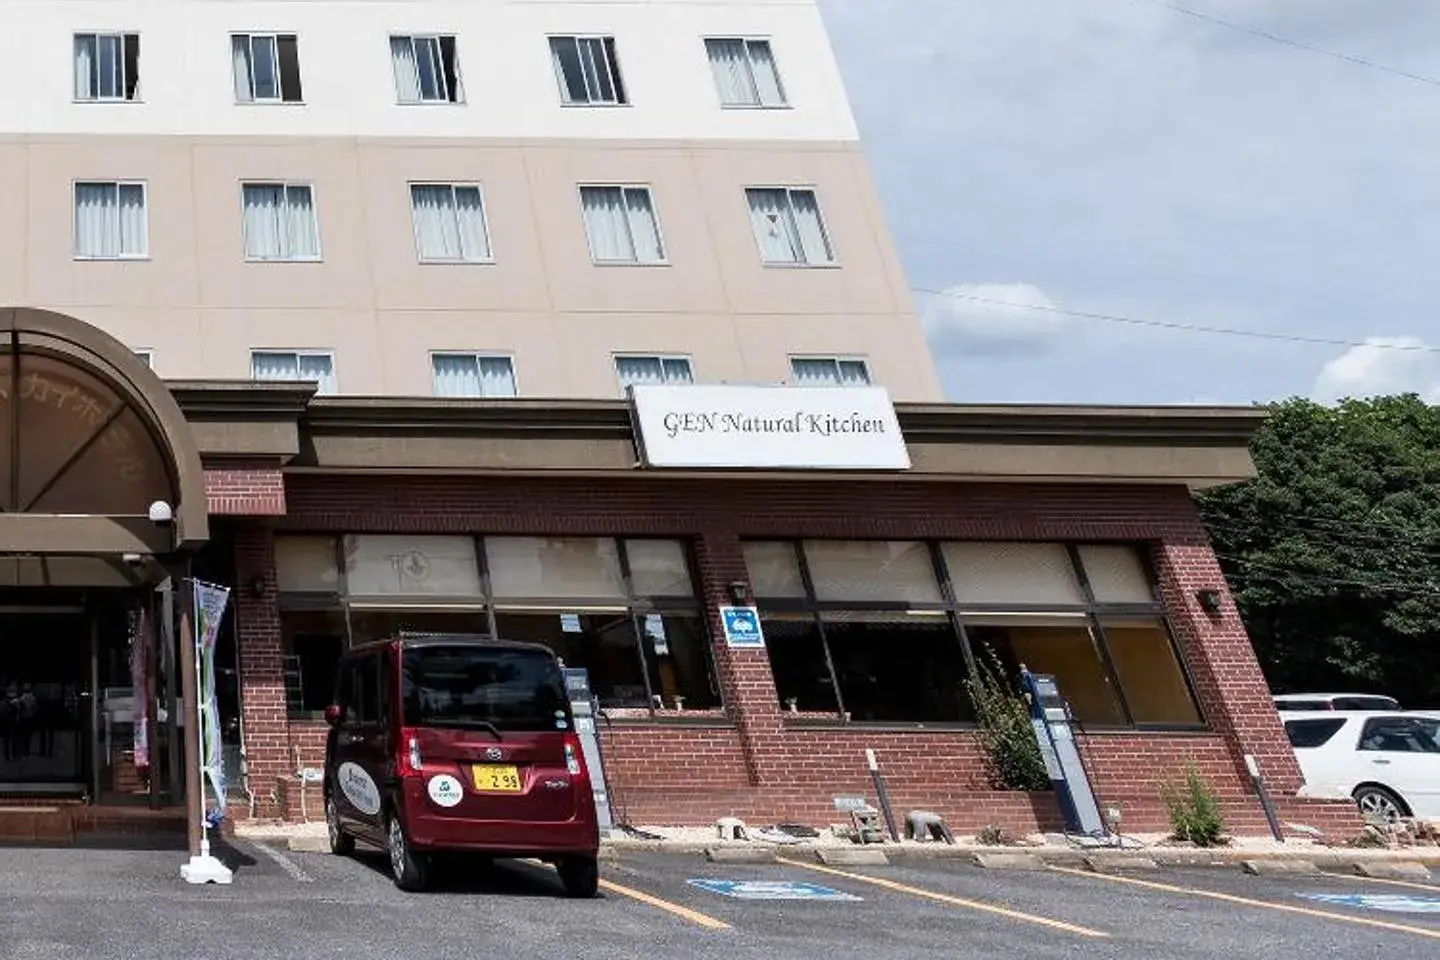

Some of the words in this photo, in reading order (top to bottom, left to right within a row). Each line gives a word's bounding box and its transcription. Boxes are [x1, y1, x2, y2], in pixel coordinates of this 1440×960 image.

[663, 411, 717, 438] GEN
[721, 412, 801, 434] Natural
[804, 412, 885, 437] Kitchen
